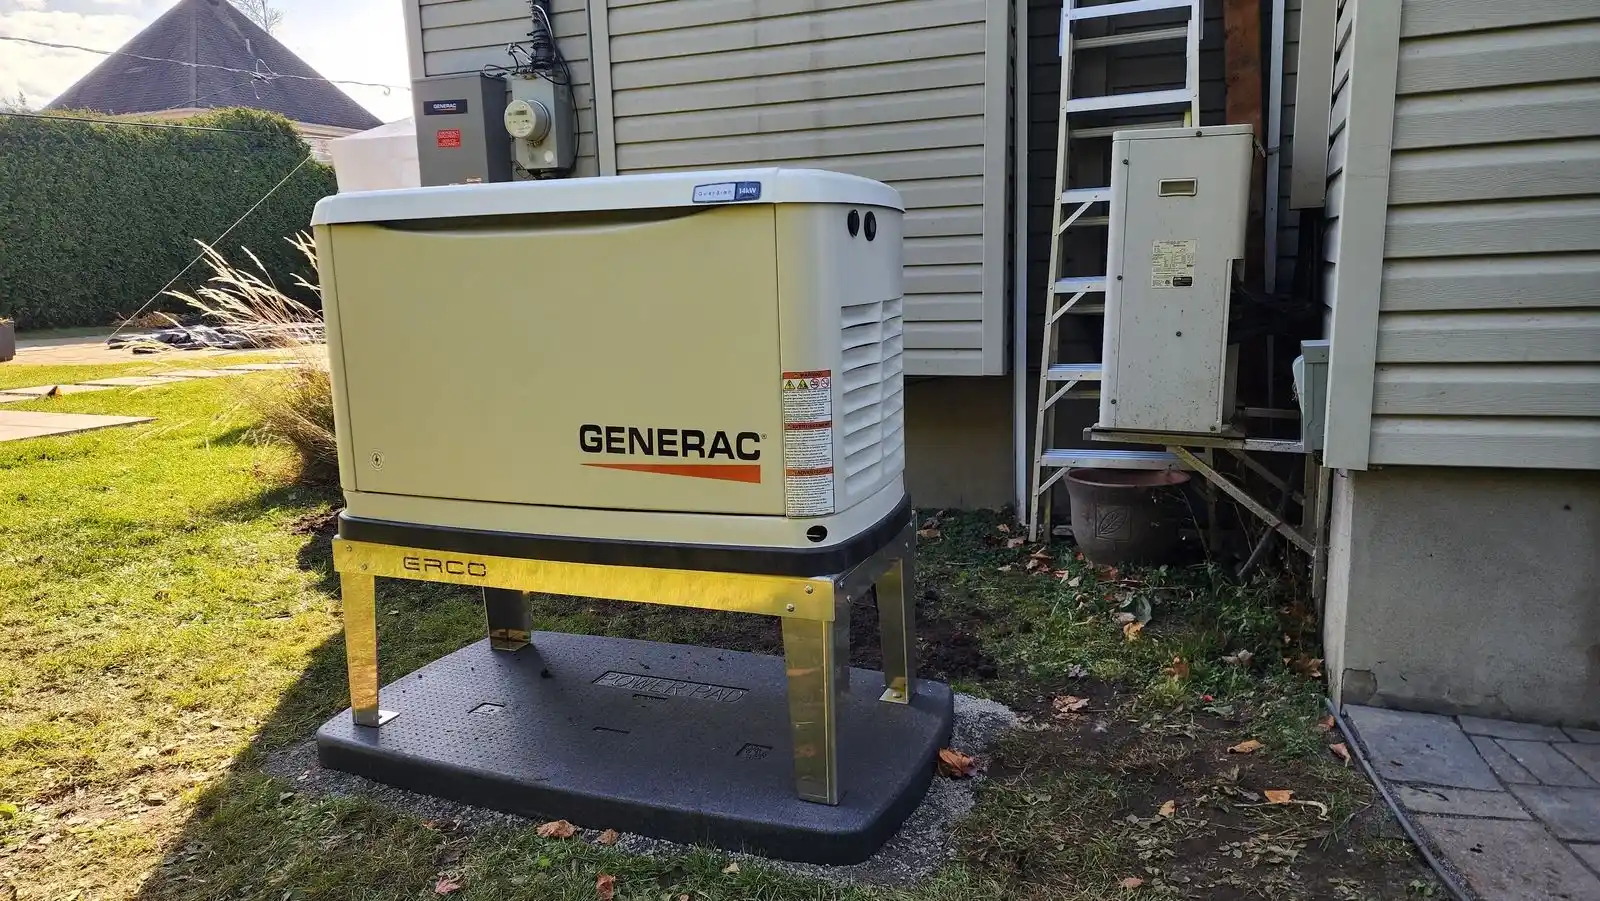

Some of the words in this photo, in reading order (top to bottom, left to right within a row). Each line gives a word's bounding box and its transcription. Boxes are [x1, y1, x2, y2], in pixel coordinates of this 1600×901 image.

[579, 424, 761, 461] GENERAC
[403, 557, 486, 576] ERCO
[596, 673, 687, 696] POWER
[689, 684, 744, 702] PAD
